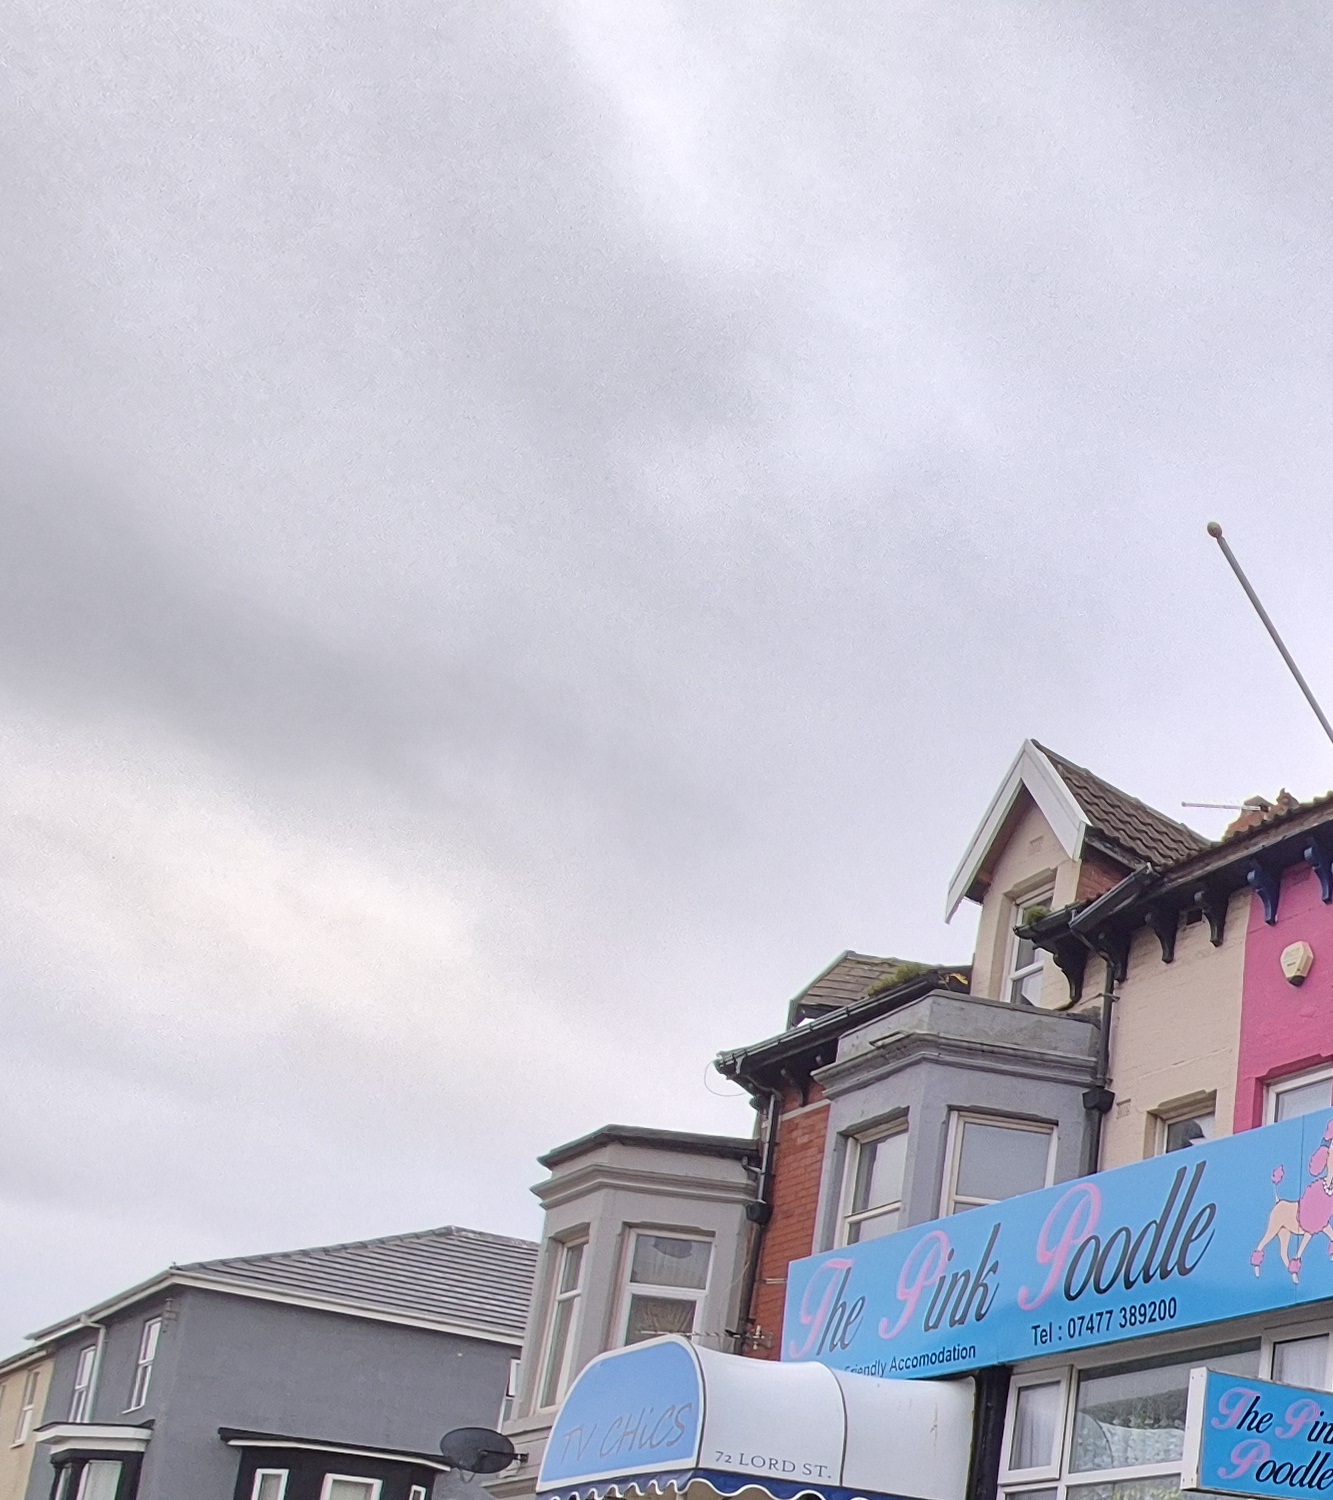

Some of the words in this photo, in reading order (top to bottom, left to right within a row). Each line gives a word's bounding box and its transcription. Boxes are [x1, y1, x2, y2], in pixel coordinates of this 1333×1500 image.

[789, 1258, 865, 1358] The
[878, 1222, 1000, 1340] Pink
[1018, 1160, 1217, 1310] Poodle
[1031, 1324, 1052, 1346] Tel
[1067, 1310, 1113, 1341] 07477
[1119, 1297, 1177, 1330] 389200
[889, 1343, 976, 1373] Accomodation
[1211, 1386, 1274, 1434] The
[560, 1424, 598, 1464] TV
[715, 1450, 732, 1464] 72
[739, 1452, 796, 1473] LORD
[802, 1462, 832, 1479] ST.
